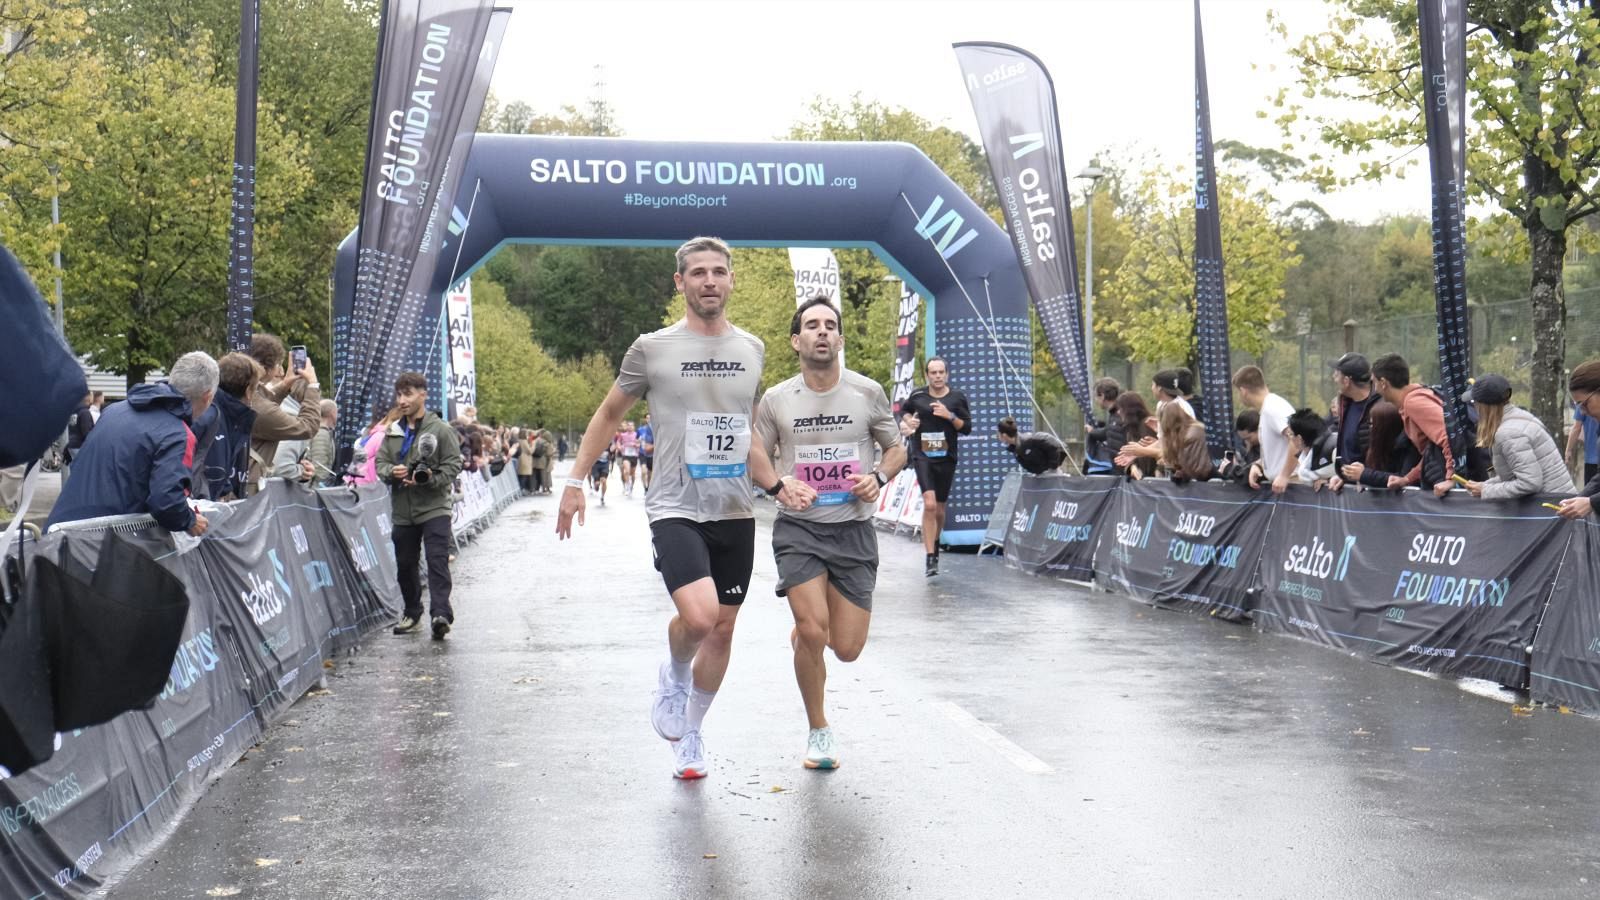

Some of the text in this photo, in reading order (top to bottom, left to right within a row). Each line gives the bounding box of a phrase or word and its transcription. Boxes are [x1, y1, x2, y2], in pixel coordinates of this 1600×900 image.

[388, 22, 451, 206] FOUNDATION
[530, 158, 858, 190] SALTO FOUNDATION .org
[624, 193, 728, 209] #BeyondSport
[691, 418, 713, 427] SALTO
[706, 434, 735, 451] 112
[928, 440, 943, 448] 758
[709, 453, 729, 461] MIKEL
[798, 451, 818, 459] SALTO
[804, 464, 853, 482] 1046
[954, 514, 982, 523] SALTO
[1052, 500, 1079, 520] SALTO
[1174, 512, 1216, 537] SALTO
[1284, 536, 1333, 579] salto
[1408, 533, 1466, 566] SALTO
